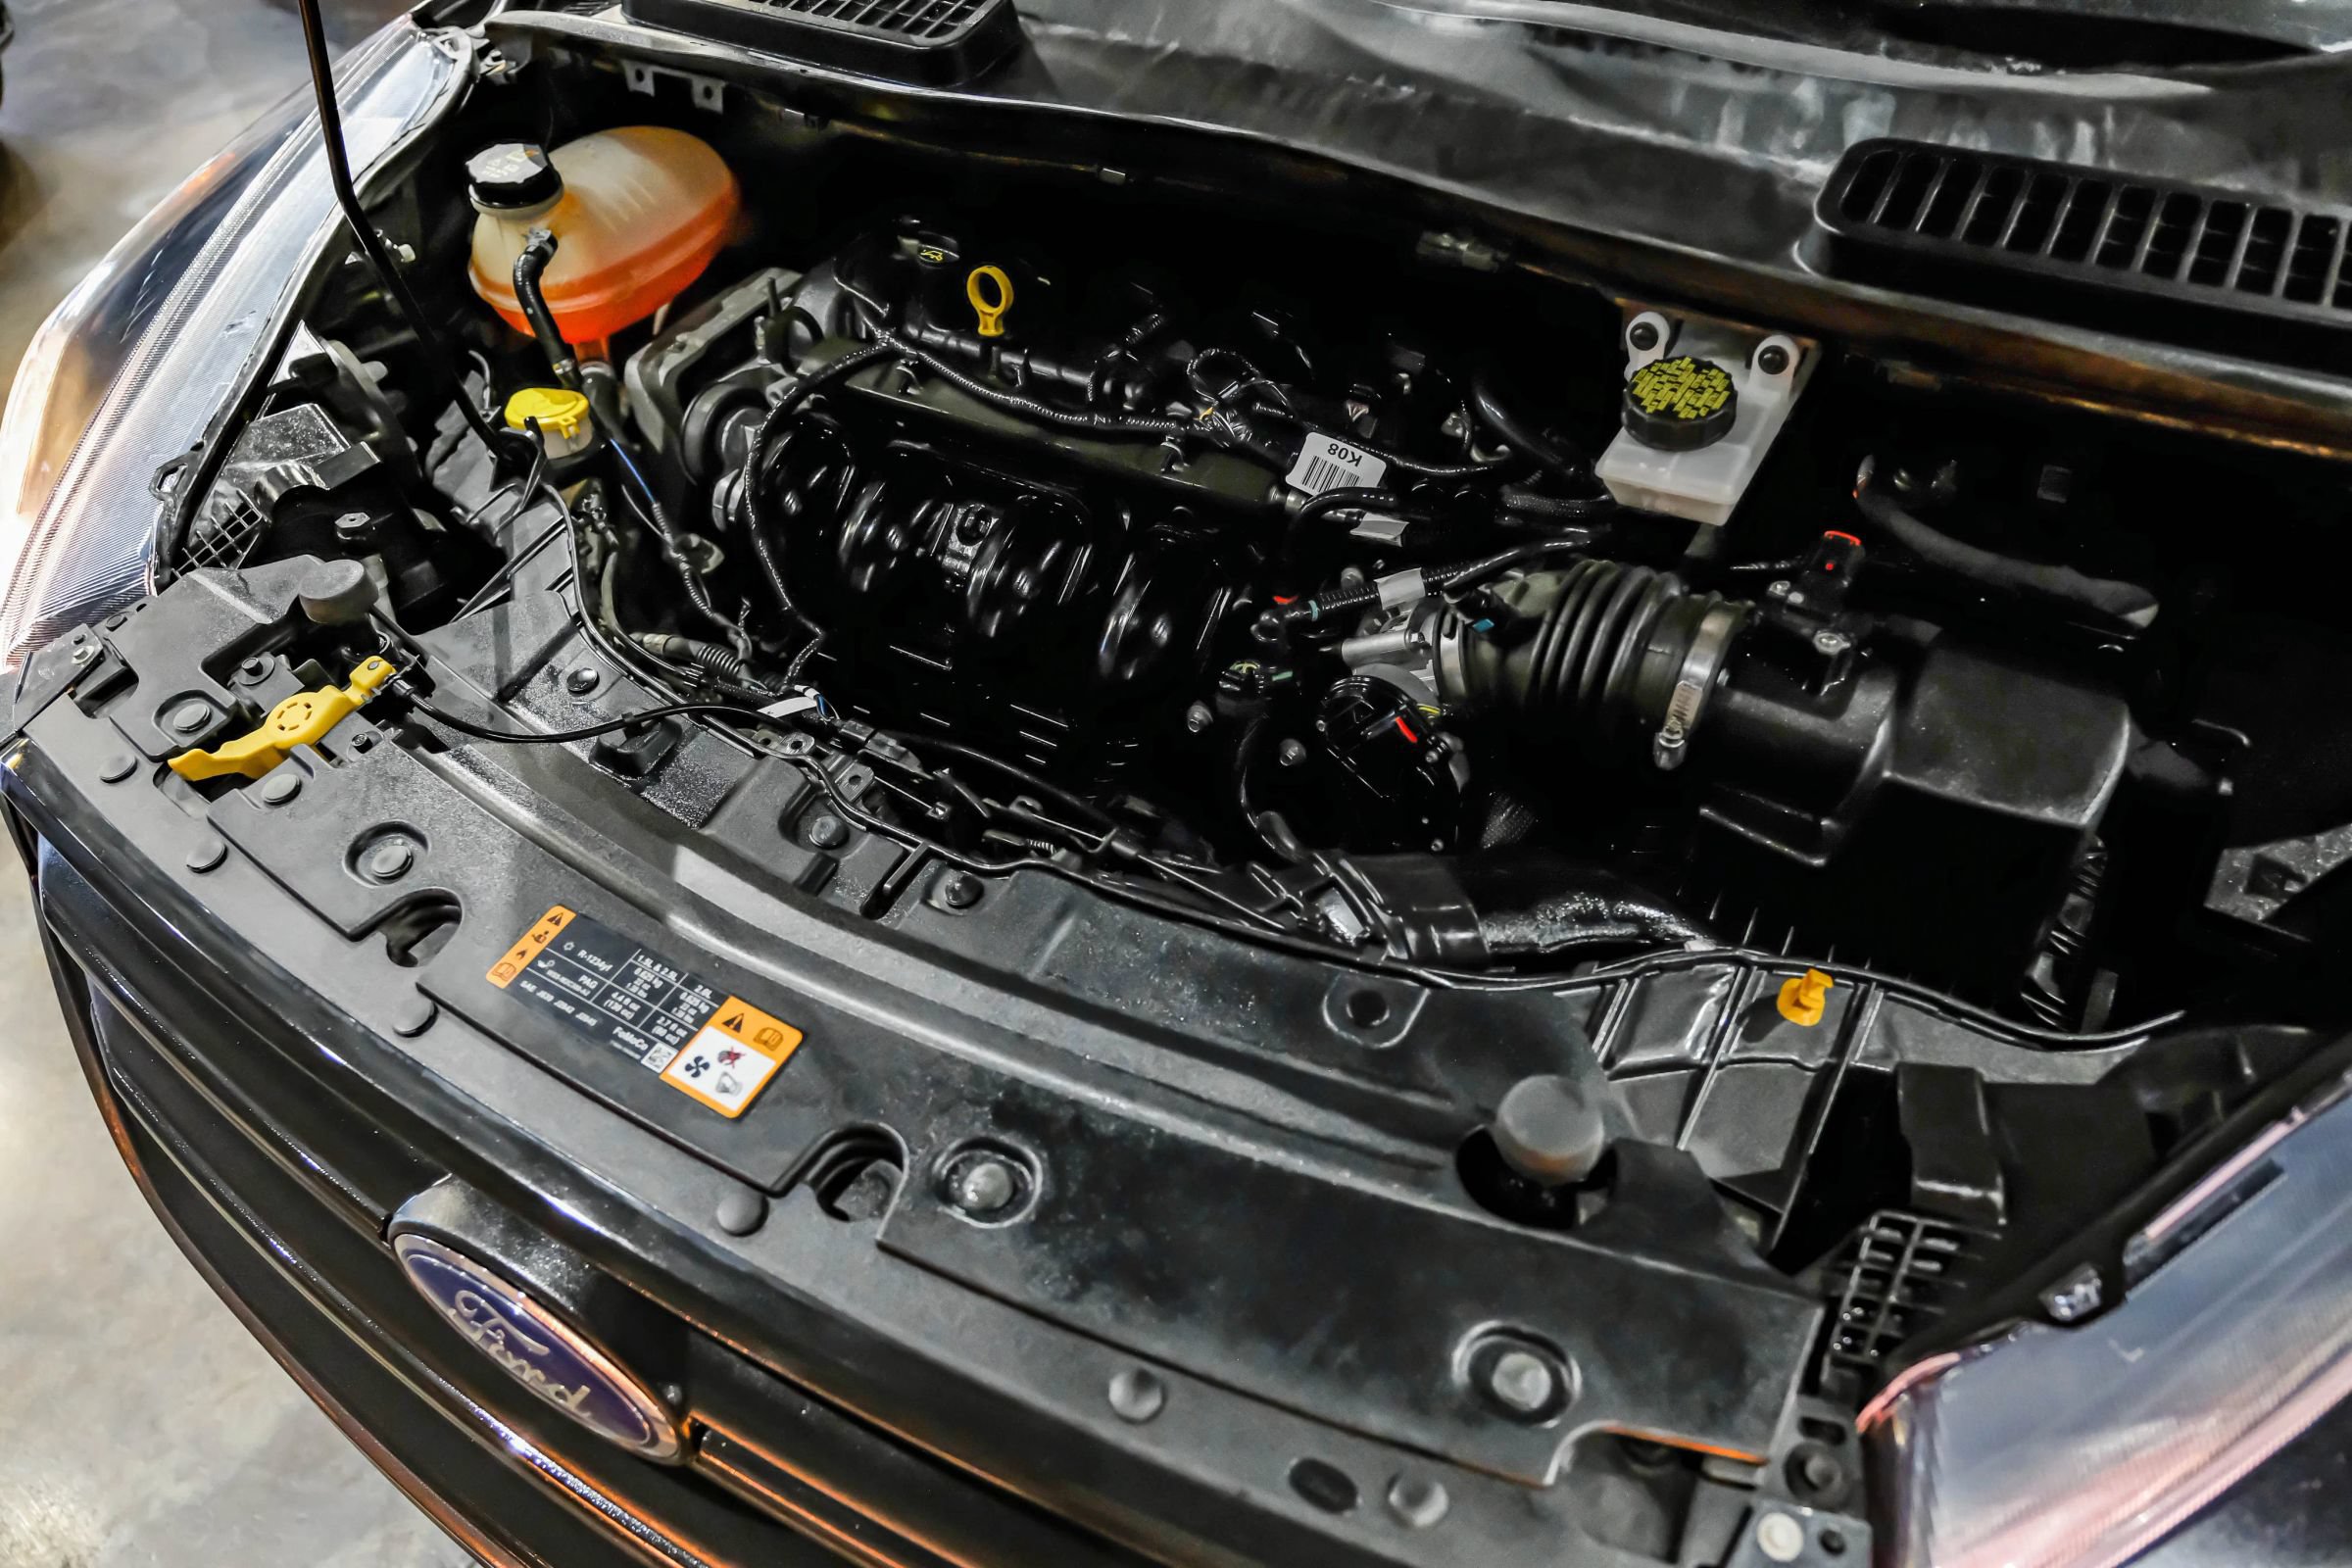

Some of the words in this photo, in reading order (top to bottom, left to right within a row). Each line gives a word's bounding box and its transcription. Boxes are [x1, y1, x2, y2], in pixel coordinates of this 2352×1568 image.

[1328, 443, 1362, 467] K08
[577, 949, 613, 972] R-1234yf
[637, 955, 654, 969] 1.5L
[652, 963, 662, 972] &
[660, 966, 678, 982] 2.5L
[519, 980, 537, 993] SAE
[577, 974, 599, 990] PAG
[651, 976, 664, 989] kg
[611, 991, 625, 1003] 4.4
[693, 984, 712, 1000] 2.0L
[698, 1002, 710, 1014] kg
[656, 1015, 672, 1027] 2.7
[612, 1026, 649, 1052] FoMoCo
[448, 1289, 591, 1417] Ford
